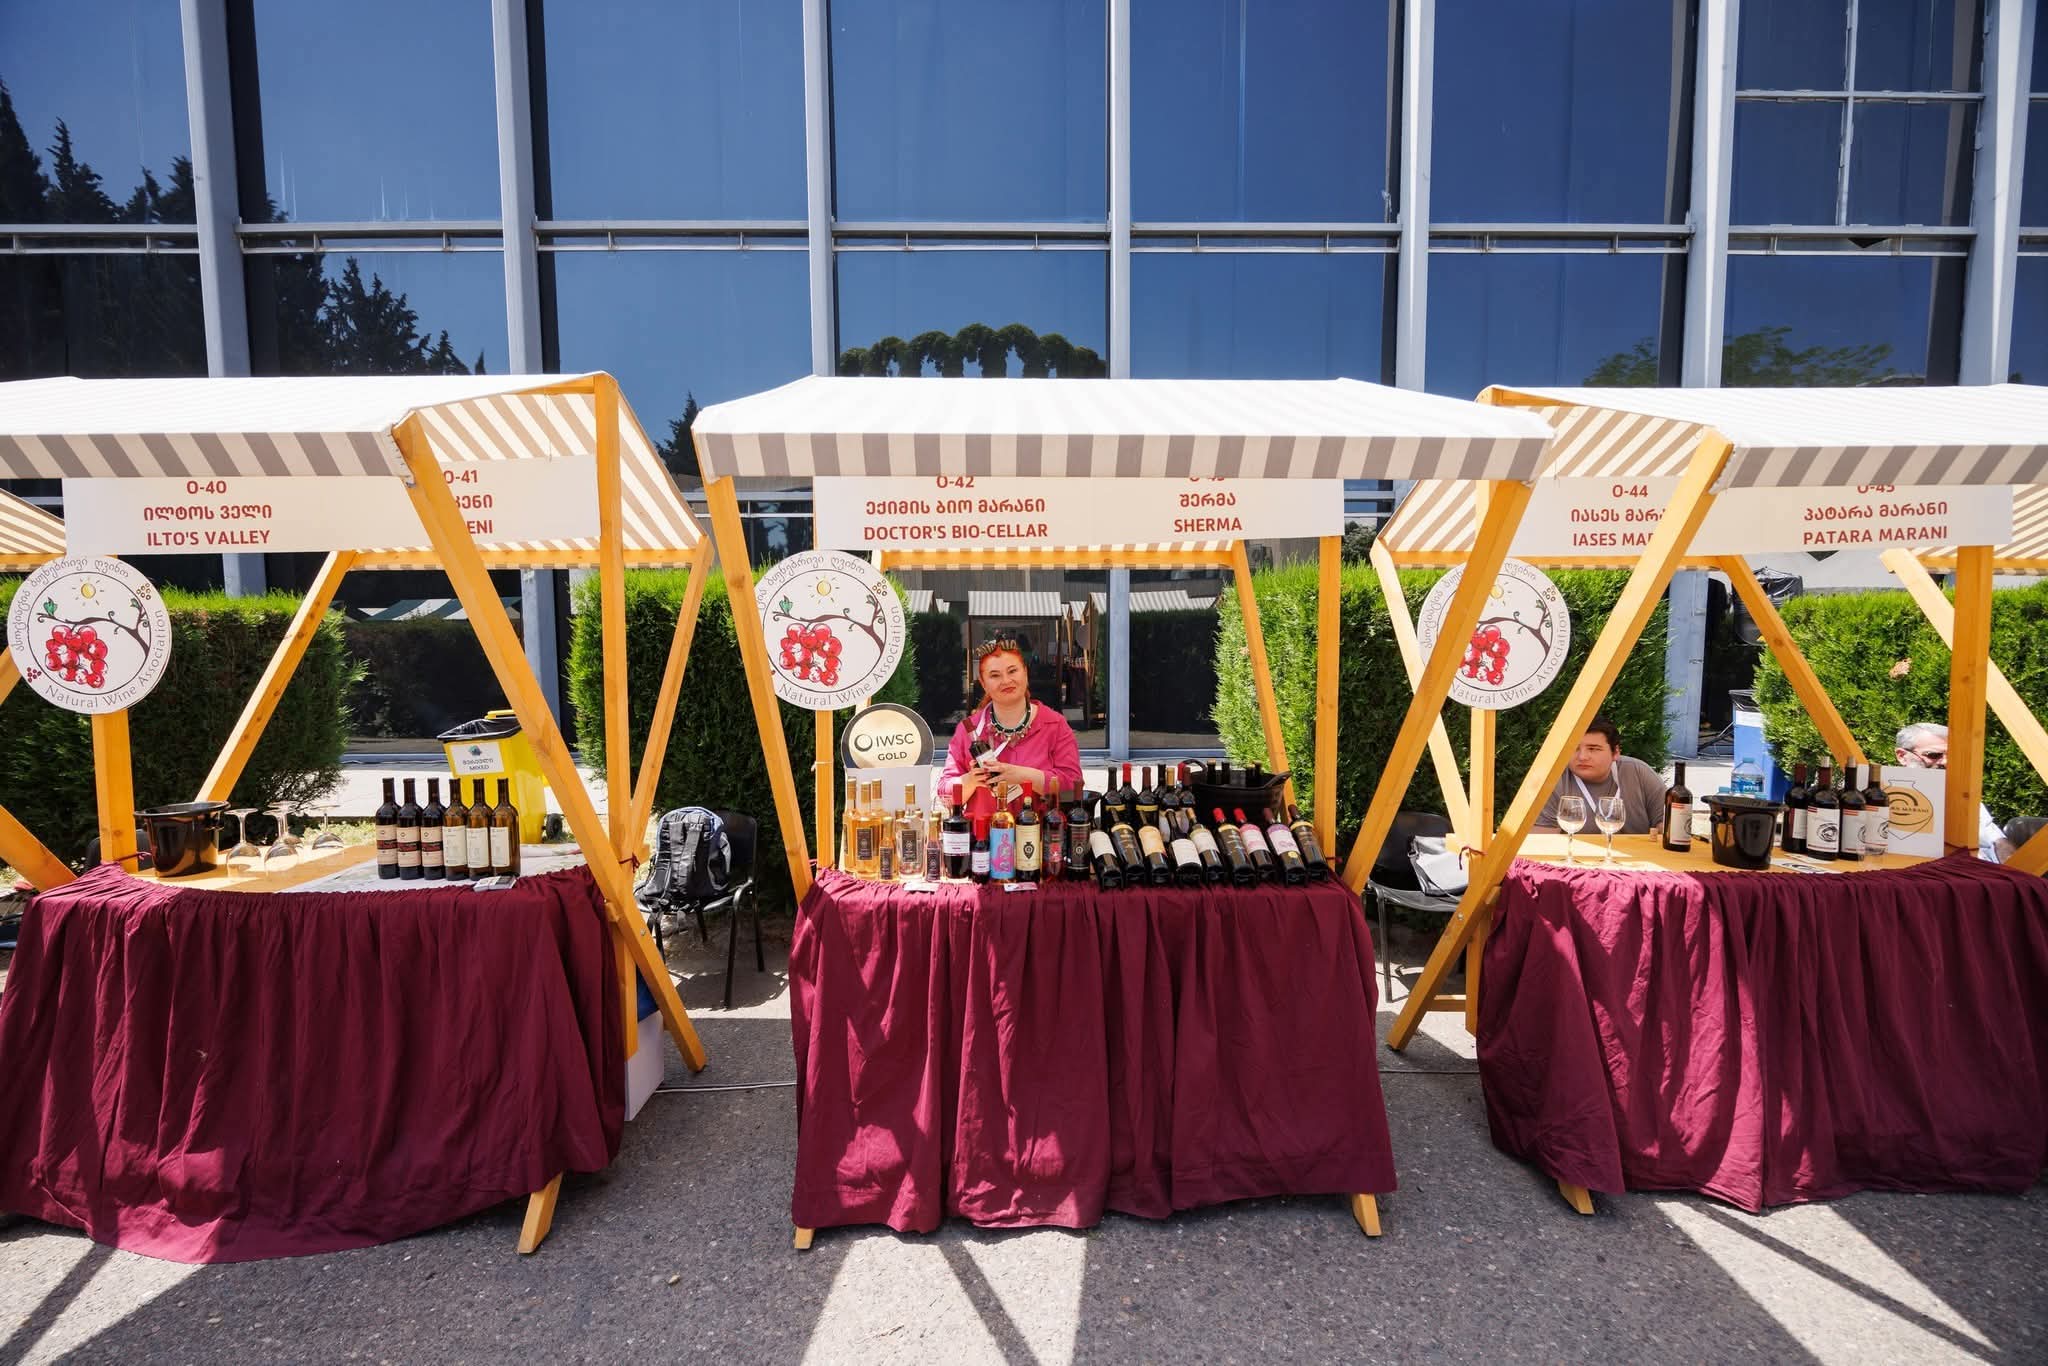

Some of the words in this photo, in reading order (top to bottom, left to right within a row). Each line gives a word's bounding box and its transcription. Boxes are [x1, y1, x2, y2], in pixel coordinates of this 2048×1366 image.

[936, 475, 975, 488] O-42
[1179, 492, 1236, 507] შერმა
[1612, 484, 1649, 498] O-44
[143, 505, 214, 521] ილტოს
[220, 504, 272, 519] ველი
[866, 500, 931, 515] ექიმის
[936, 499, 973, 514] ბიო
[978, 498, 1046, 513] მარანი
[1571, 508, 1620, 522] იასეს
[1803, 505, 1873, 521] პატარა
[1879, 501, 1948, 518] მარანი
[864, 525, 946, 540] DOCTOR'S
[952, 523, 1048, 539] BIO-CELLAR
[1174, 517, 1243, 533] SHERMA
[147, 531, 200, 546] ILTO'S
[204, 530, 271, 545] VALLEY
[1573, 532, 1617, 546] IASES
[1803, 529, 1873, 545] PATARA
[1879, 525, 1948, 542] MARANI
[94, 559, 129, 578] ღვინო
[830, 556, 866, 576] ღვინო
[44, 685, 99, 708] Natural
[103, 686, 137, 706] Wine
[138, 609, 166, 687] Association
[779, 683, 832, 706] Natural
[836, 684, 872, 705] Wine
[872, 605, 901, 683] Association
[1500, 682, 1537, 703] Wine
[1536, 611, 1567, 684] Association
[876, 733, 914, 747] IWSC
[877, 751, 908, 761] GOLD
